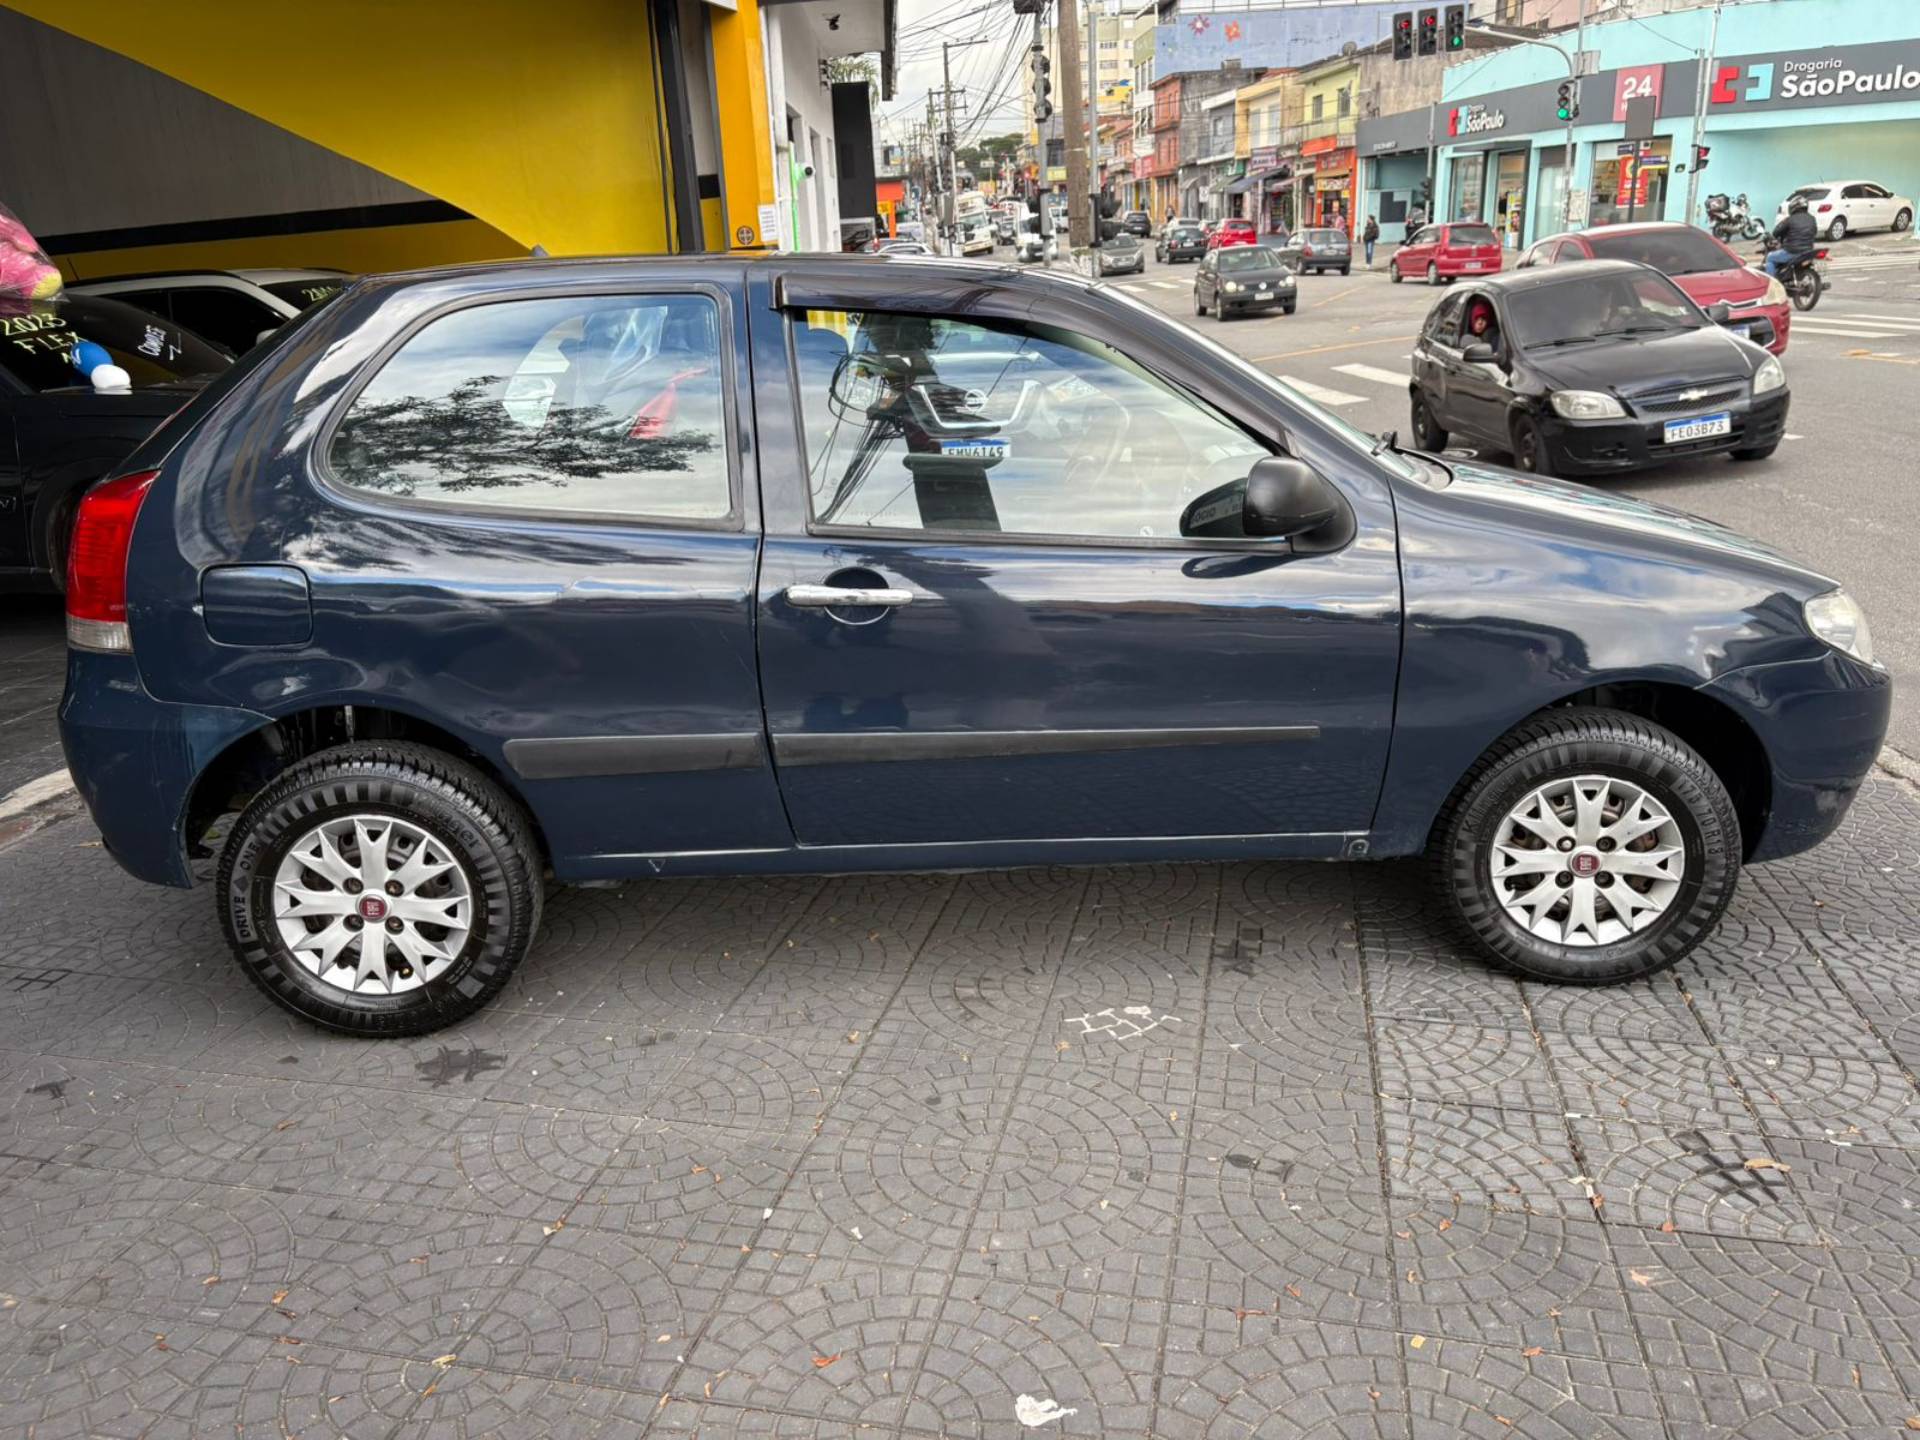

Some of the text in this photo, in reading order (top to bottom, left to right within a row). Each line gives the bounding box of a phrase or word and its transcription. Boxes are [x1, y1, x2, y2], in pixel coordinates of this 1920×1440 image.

[1783, 58, 1842, 73] Drogaria
[1621, 75, 1652, 100] 24
[233, 841, 257, 938] DRIVE ONE
